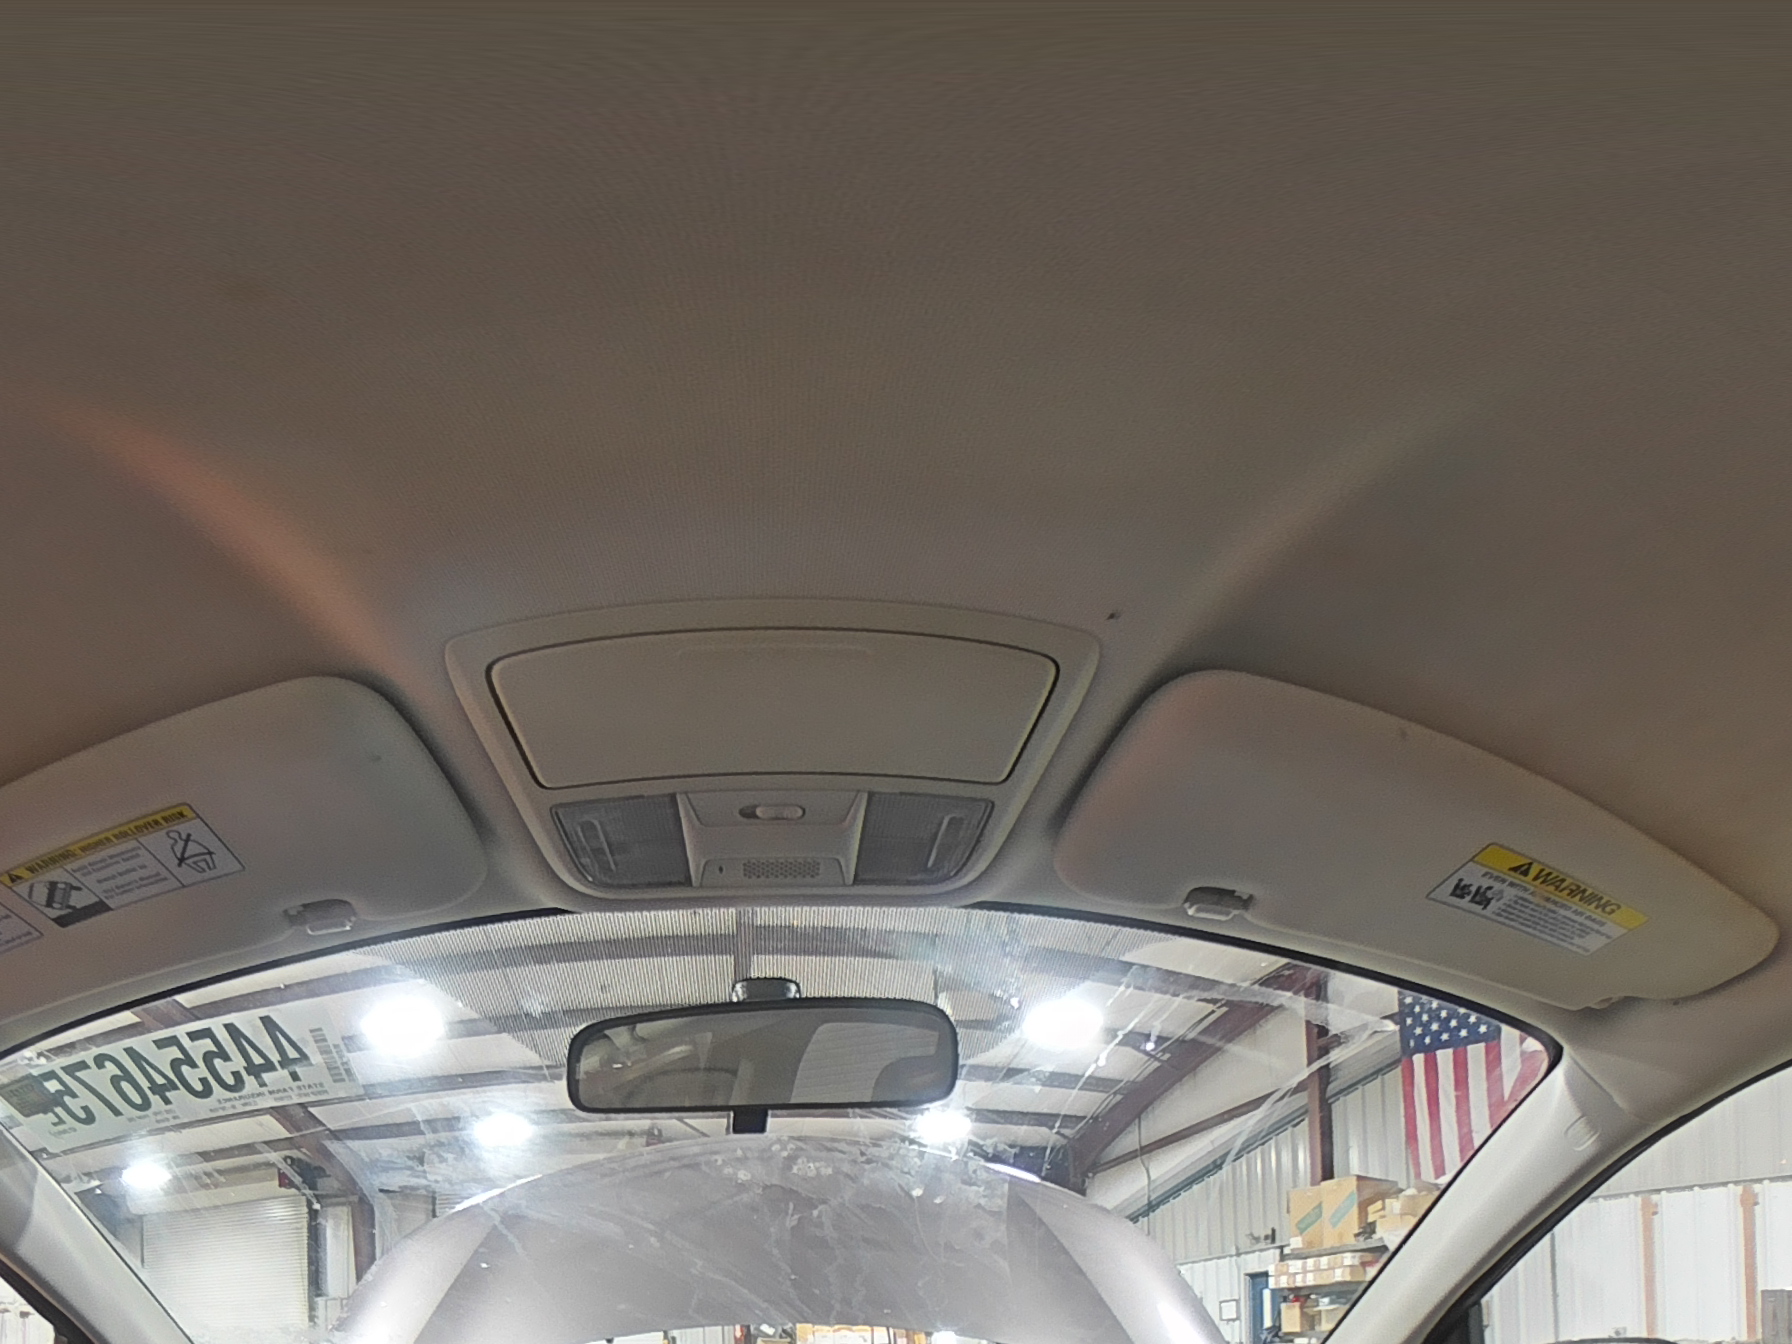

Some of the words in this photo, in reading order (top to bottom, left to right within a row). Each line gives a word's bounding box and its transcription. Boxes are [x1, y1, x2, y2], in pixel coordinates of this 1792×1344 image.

[113, 819, 163, 844] ROLLOVER
[164, 809, 188, 826] RISK
[1532, 868, 1622, 916] WARNING
